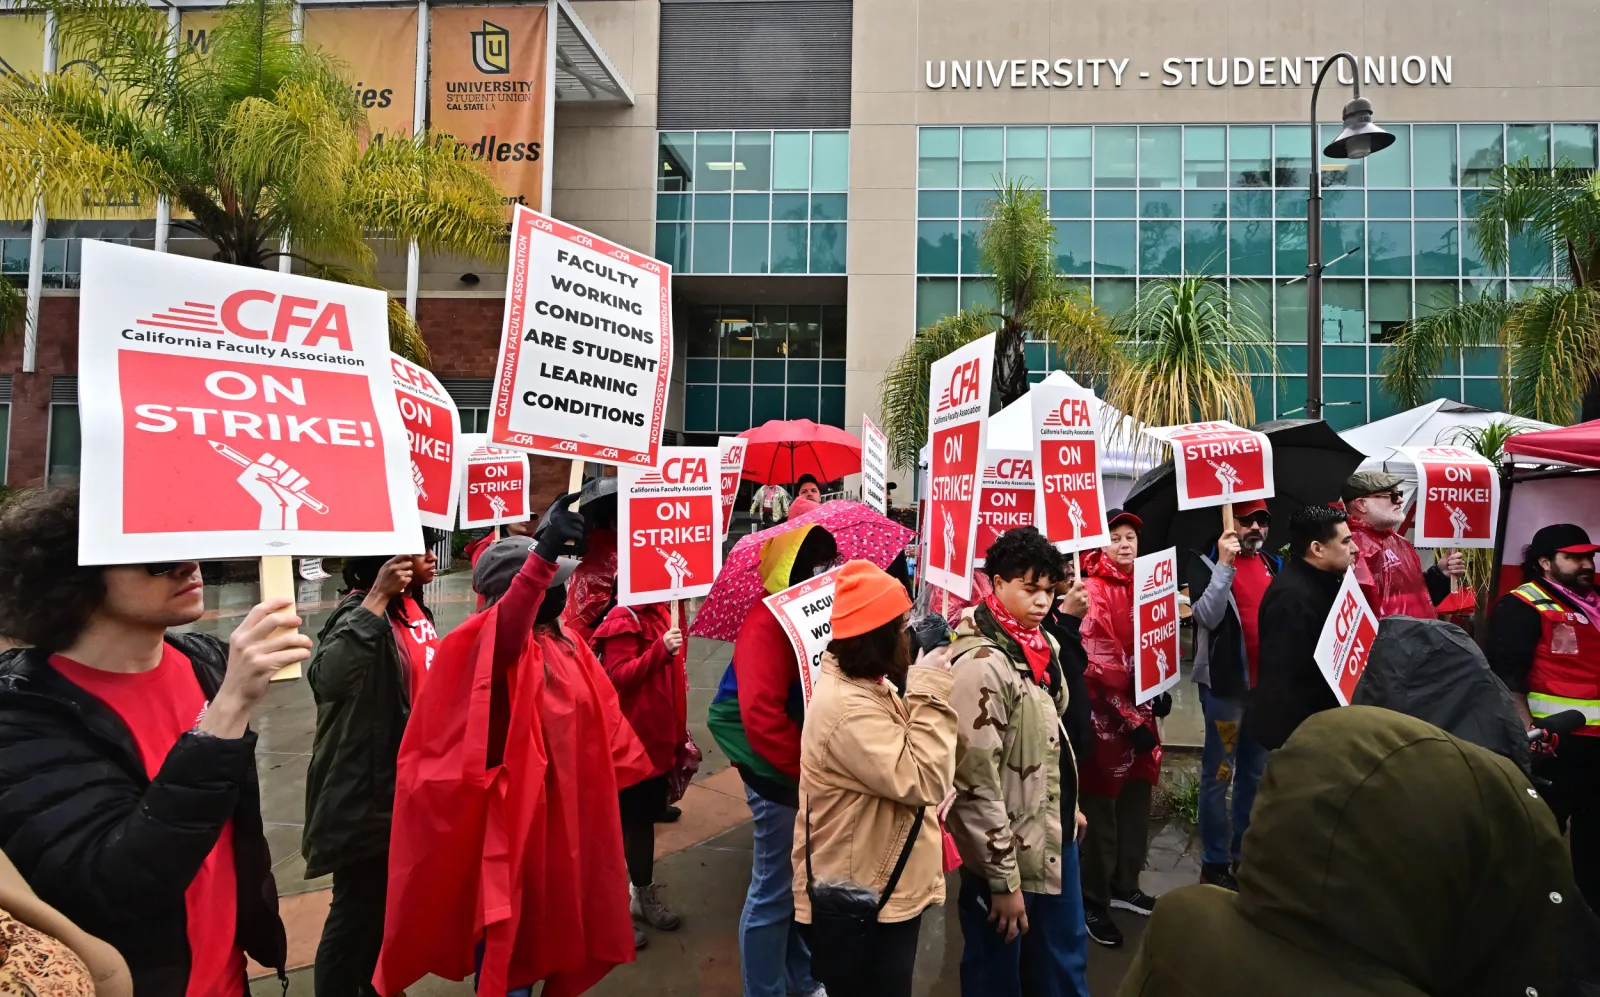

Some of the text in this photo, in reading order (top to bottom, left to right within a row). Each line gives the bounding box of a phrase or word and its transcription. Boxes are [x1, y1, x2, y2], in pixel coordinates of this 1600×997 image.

[925, 58, 1130, 89] UNIVERSITY
[1161, 56, 1325, 87] STUDENT
[1335, 54, 1453, 86] UNION
[446, 80, 534, 93] UNIVERSITY
[446, 93, 532, 103] STUDENT UNION
[446, 103, 462, 111] CAL
[463, 103, 484, 111] STATE
[535, 219, 553, 233] CFA
[576, 234, 593, 248] CFA
[614, 249, 630, 263] CFA
[646, 261, 661, 275] CFA
[556, 249, 639, 289] FACULTY
[551, 275, 643, 316] WORKING
[220, 289, 354, 352] CFA
[498, 235, 528, 417] CALIFORNIA FACULTY ASSOCIATION
[535, 300, 654, 345] CONDITIONS
[121, 327, 365, 367] California Faculty Association
[524, 328, 658, 373] ARE STUDENT
[390, 357, 440, 396] CFA
[650, 286, 669, 444] CALIFORNIA FACULTY ASSOCIATION
[204, 370, 306, 406] ON
[539, 362, 638, 397] LEARNING
[949, 357, 980, 408] CFA
[399, 397, 432, 428] ON
[522, 390, 645, 427] CONDITIONS
[934, 405, 981, 425] California Faculty Association
[1059, 398, 1091, 427] CFA
[134, 403, 376, 448] STRIKE!
[1040, 428, 1095, 436] California Faculty Association
[406, 428, 451, 463] RIKE!
[513, 433, 534, 446] CFA
[559, 440, 578, 453] CFA
[944, 433, 963, 464] ON
[1186, 437, 1260, 461] STRIKE!
[602, 447, 619, 459] CFA
[635, 453, 651, 464] CFA
[1058, 445, 1082, 466] ON
[484, 465, 508, 478] ON
[661, 457, 709, 485] CFA
[996, 458, 1033, 480] CFA
[1444, 466, 1472, 483] ON
[469, 479, 522, 495] STRIKE!
[630, 485, 660, 494] California
[660, 485, 681, 494] Faculty
[721, 476, 733, 490] ON
[932, 473, 974, 502] STRIKE!
[1044, 472, 1096, 494] STRIKE!
[1428, 486, 1490, 503] STRIKE!
[656, 501, 690, 521] ON
[990, 491, 1017, 507] ON
[977, 511, 1033, 526] STRIKE!
[632, 525, 711, 548] STRIKE!
[1153, 558, 1173, 588] CFA
[1151, 600, 1167, 622] ON
[1335, 589, 1358, 643] CFA
[409, 618, 438, 645] CFA
[781, 614, 808, 668] ASSOCIATION
[1141, 619, 1176, 650] STRIKE!
[1348, 637, 1365, 676] ON
